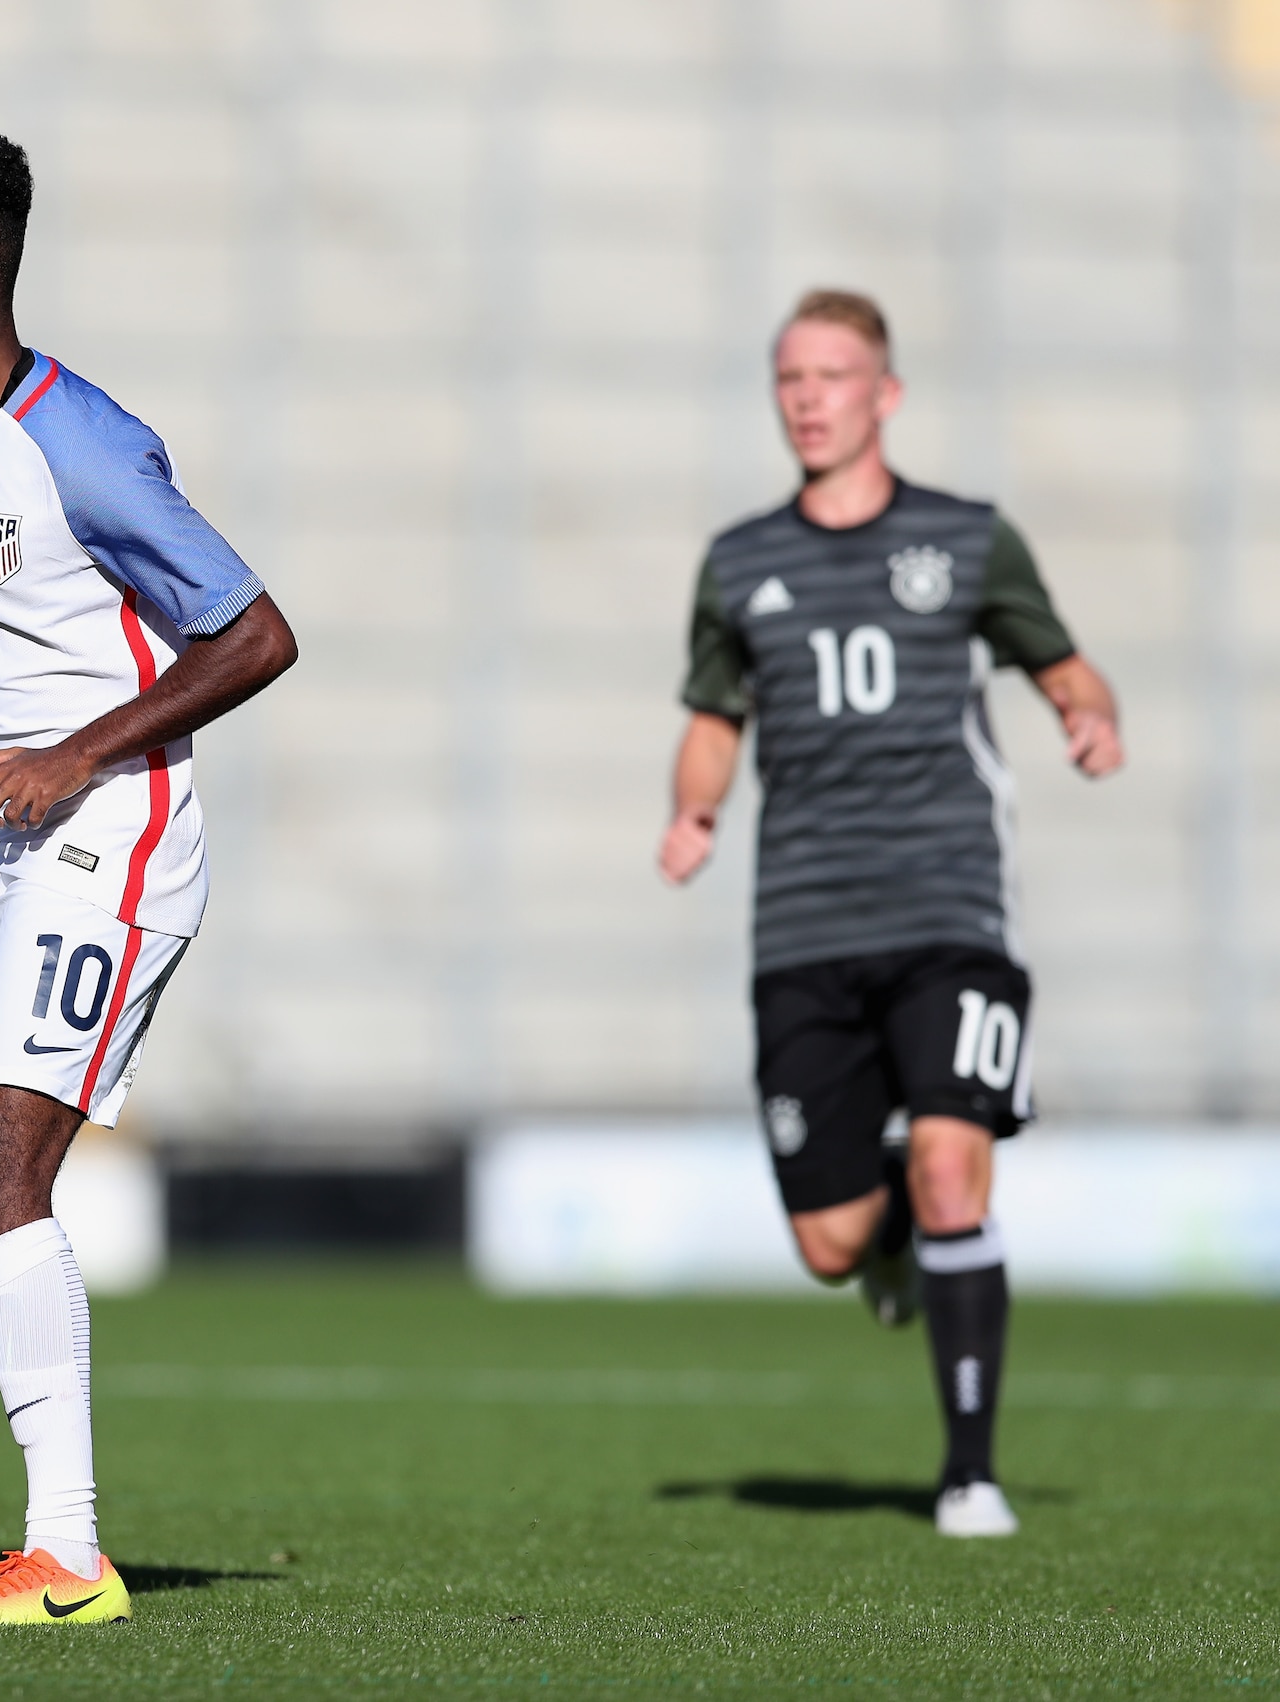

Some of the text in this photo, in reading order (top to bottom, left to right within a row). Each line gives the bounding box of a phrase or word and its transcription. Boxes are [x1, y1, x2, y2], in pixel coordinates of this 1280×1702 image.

[807, 625, 897, 717] 10
[31, 934, 113, 1032] 10
[952, 987, 1020, 1091] 10
